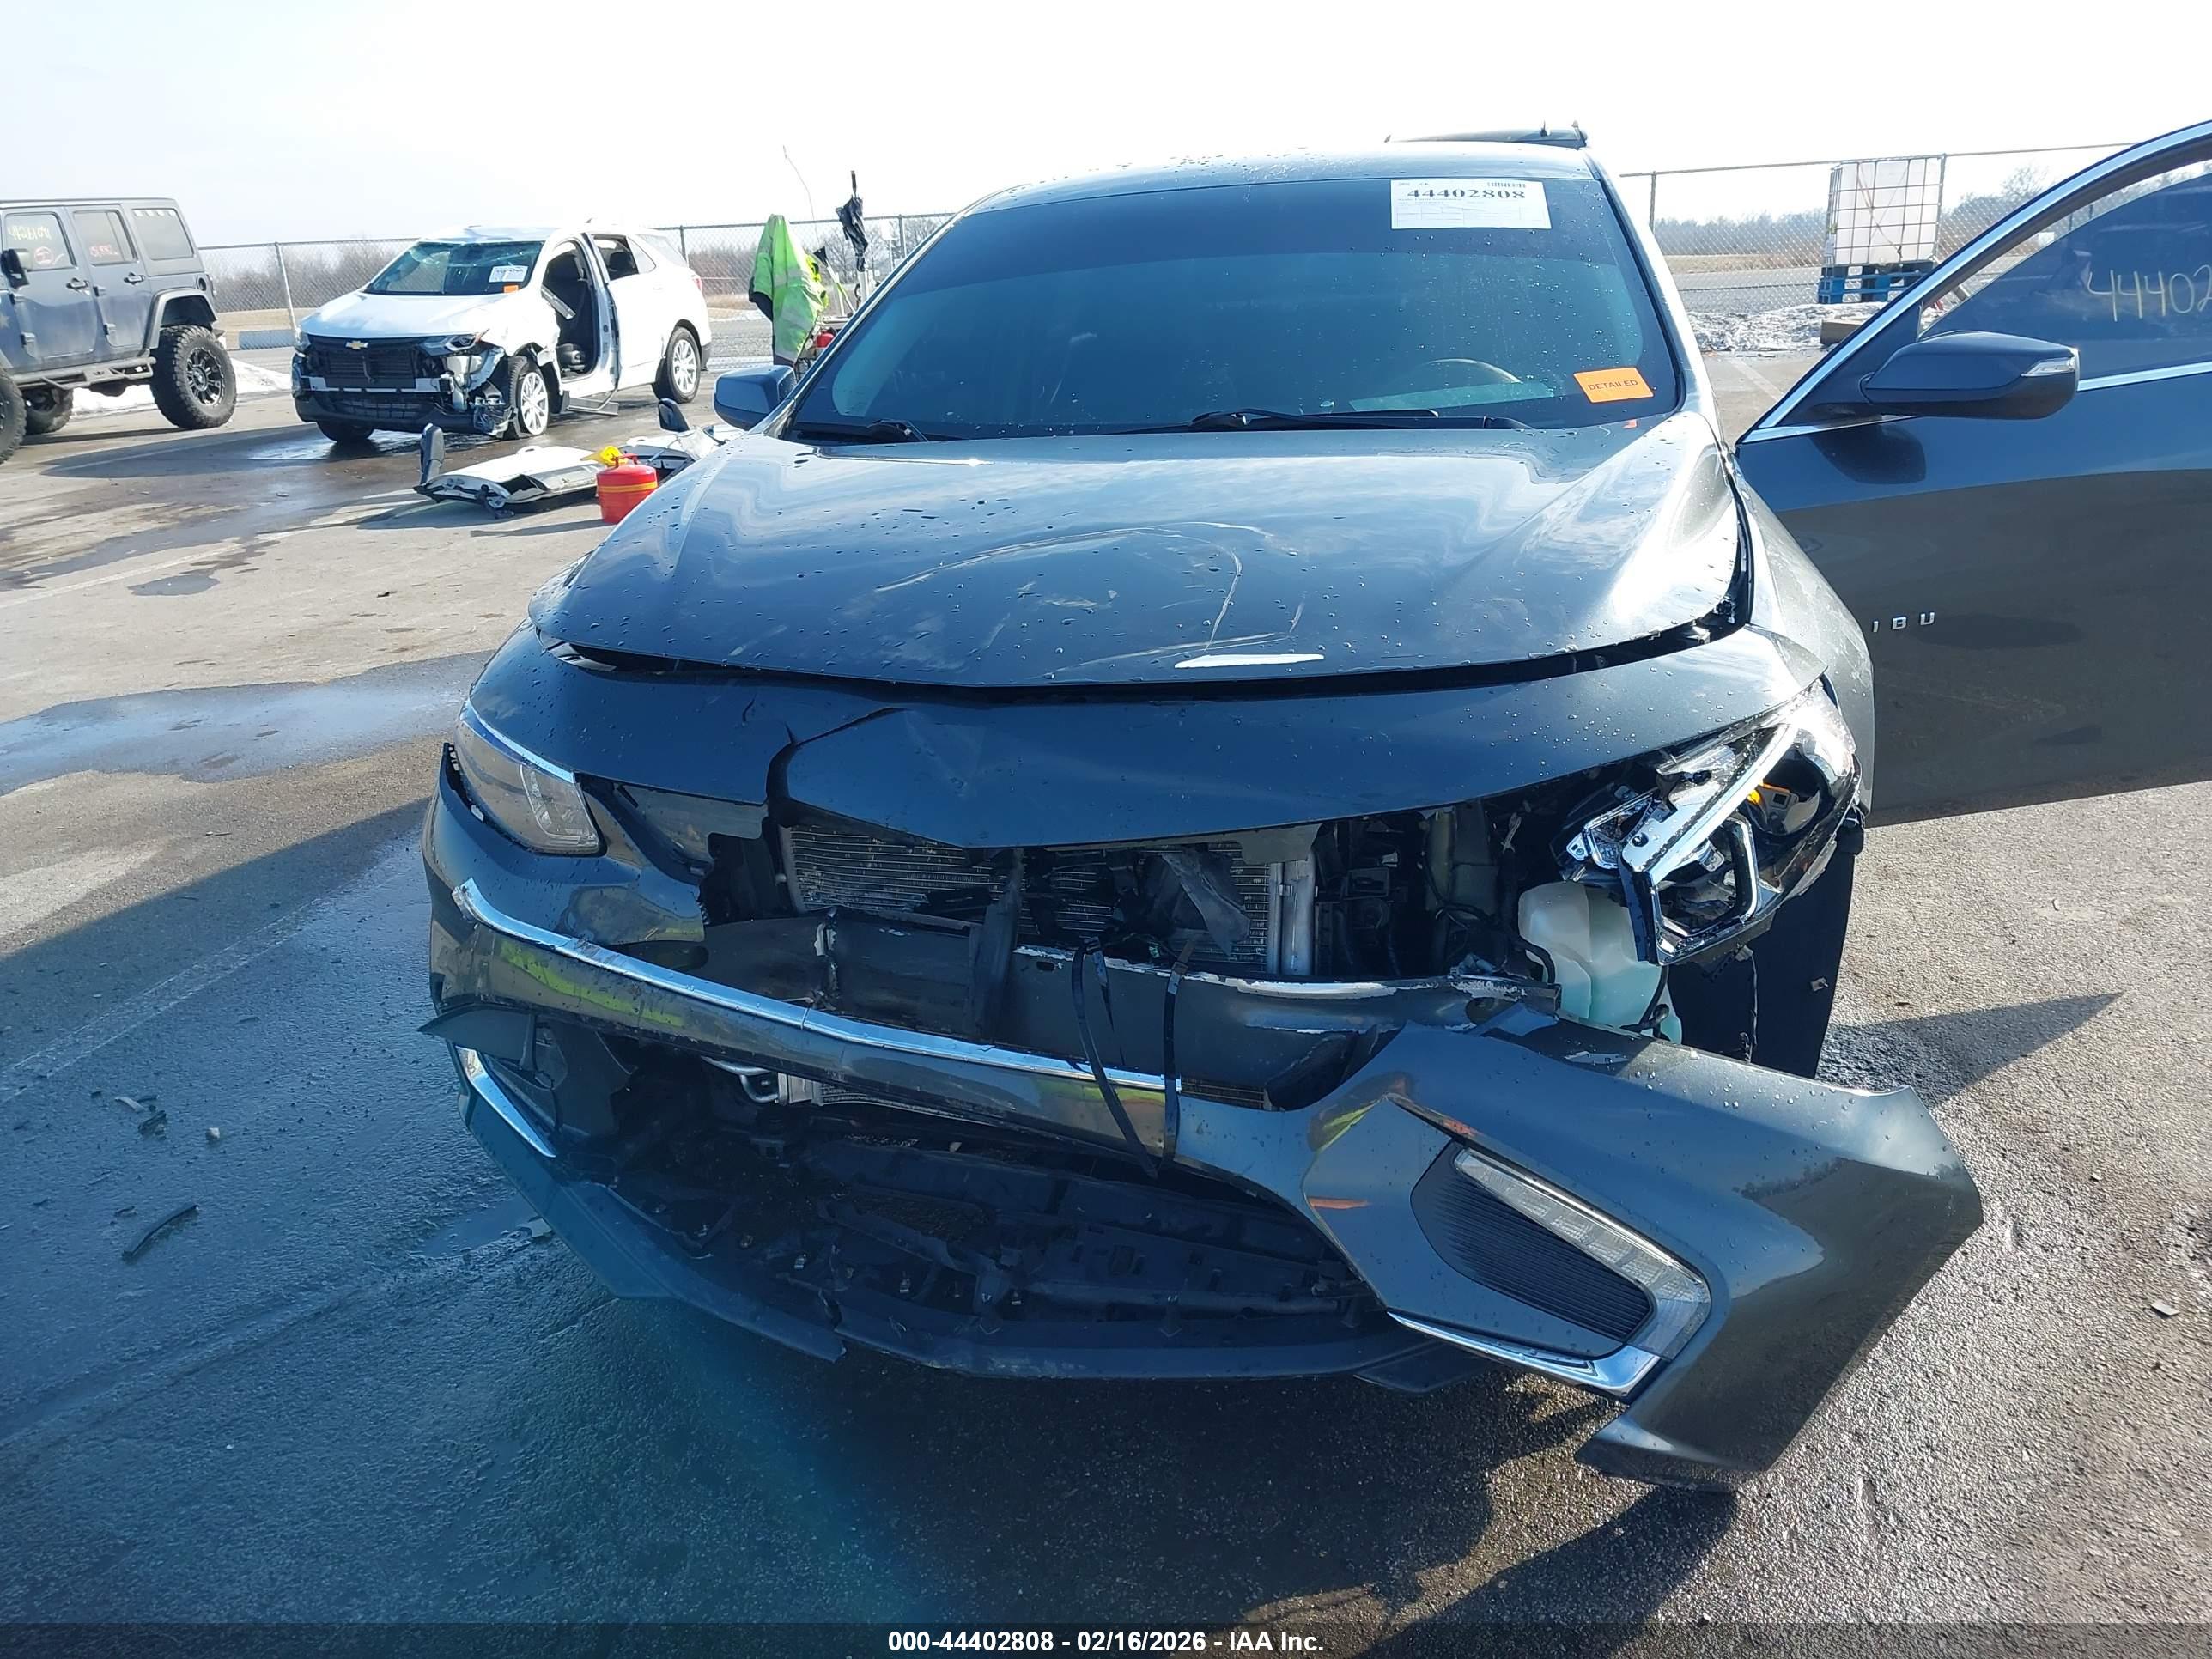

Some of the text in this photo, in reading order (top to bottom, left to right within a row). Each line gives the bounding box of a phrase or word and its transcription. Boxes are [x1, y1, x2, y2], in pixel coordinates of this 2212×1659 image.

[1407, 188, 1527, 200] 44402808
[2087, 264, 2212, 323] 44402
[1587, 380, 1638, 391] DETAILED
